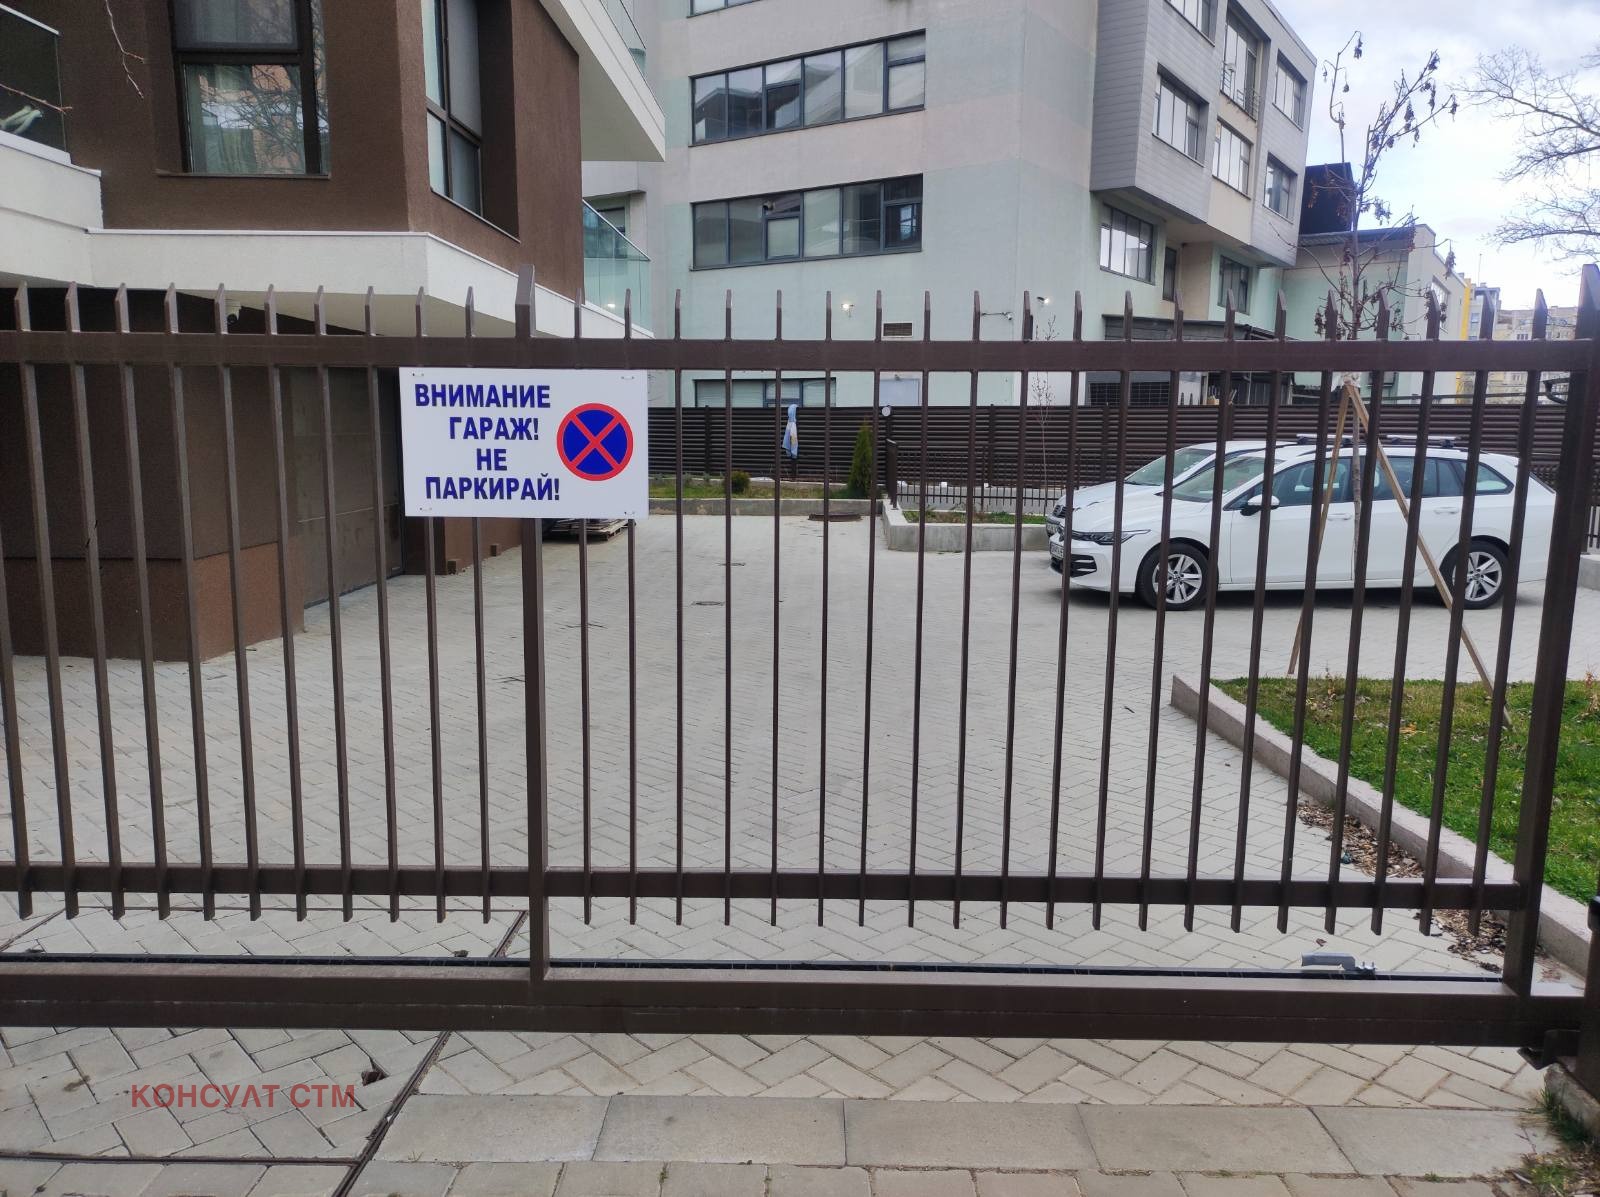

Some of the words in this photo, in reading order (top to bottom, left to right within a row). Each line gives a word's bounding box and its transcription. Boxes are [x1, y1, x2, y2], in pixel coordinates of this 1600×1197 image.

[415, 384, 551, 408] ВНИМАНИЕ
[450, 417, 539, 440] ГАРАЖ!
[476, 448, 507, 471] НЕ
[426, 473, 560, 500] ПАРКИРАЙ!
